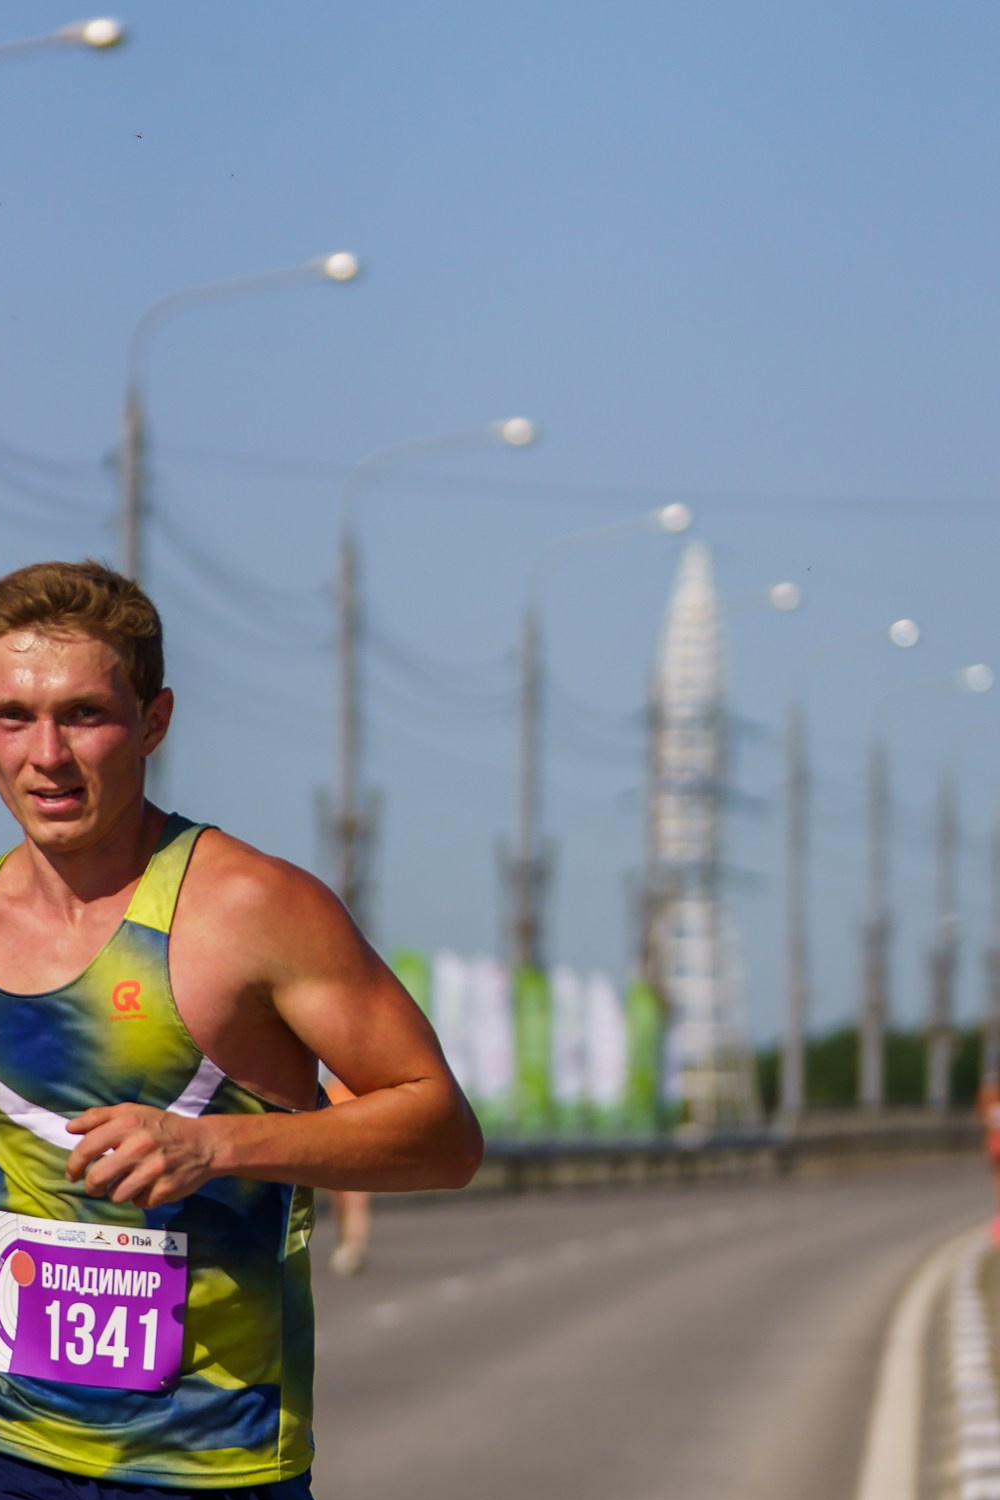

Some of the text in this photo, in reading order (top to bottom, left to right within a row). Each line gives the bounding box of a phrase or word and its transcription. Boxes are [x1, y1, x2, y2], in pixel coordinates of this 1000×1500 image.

[131, 1235, 152, 1247] Пэй
[41, 1261, 162, 1298] ВЛАДИМИР
[45, 1299, 159, 1371] 1341
